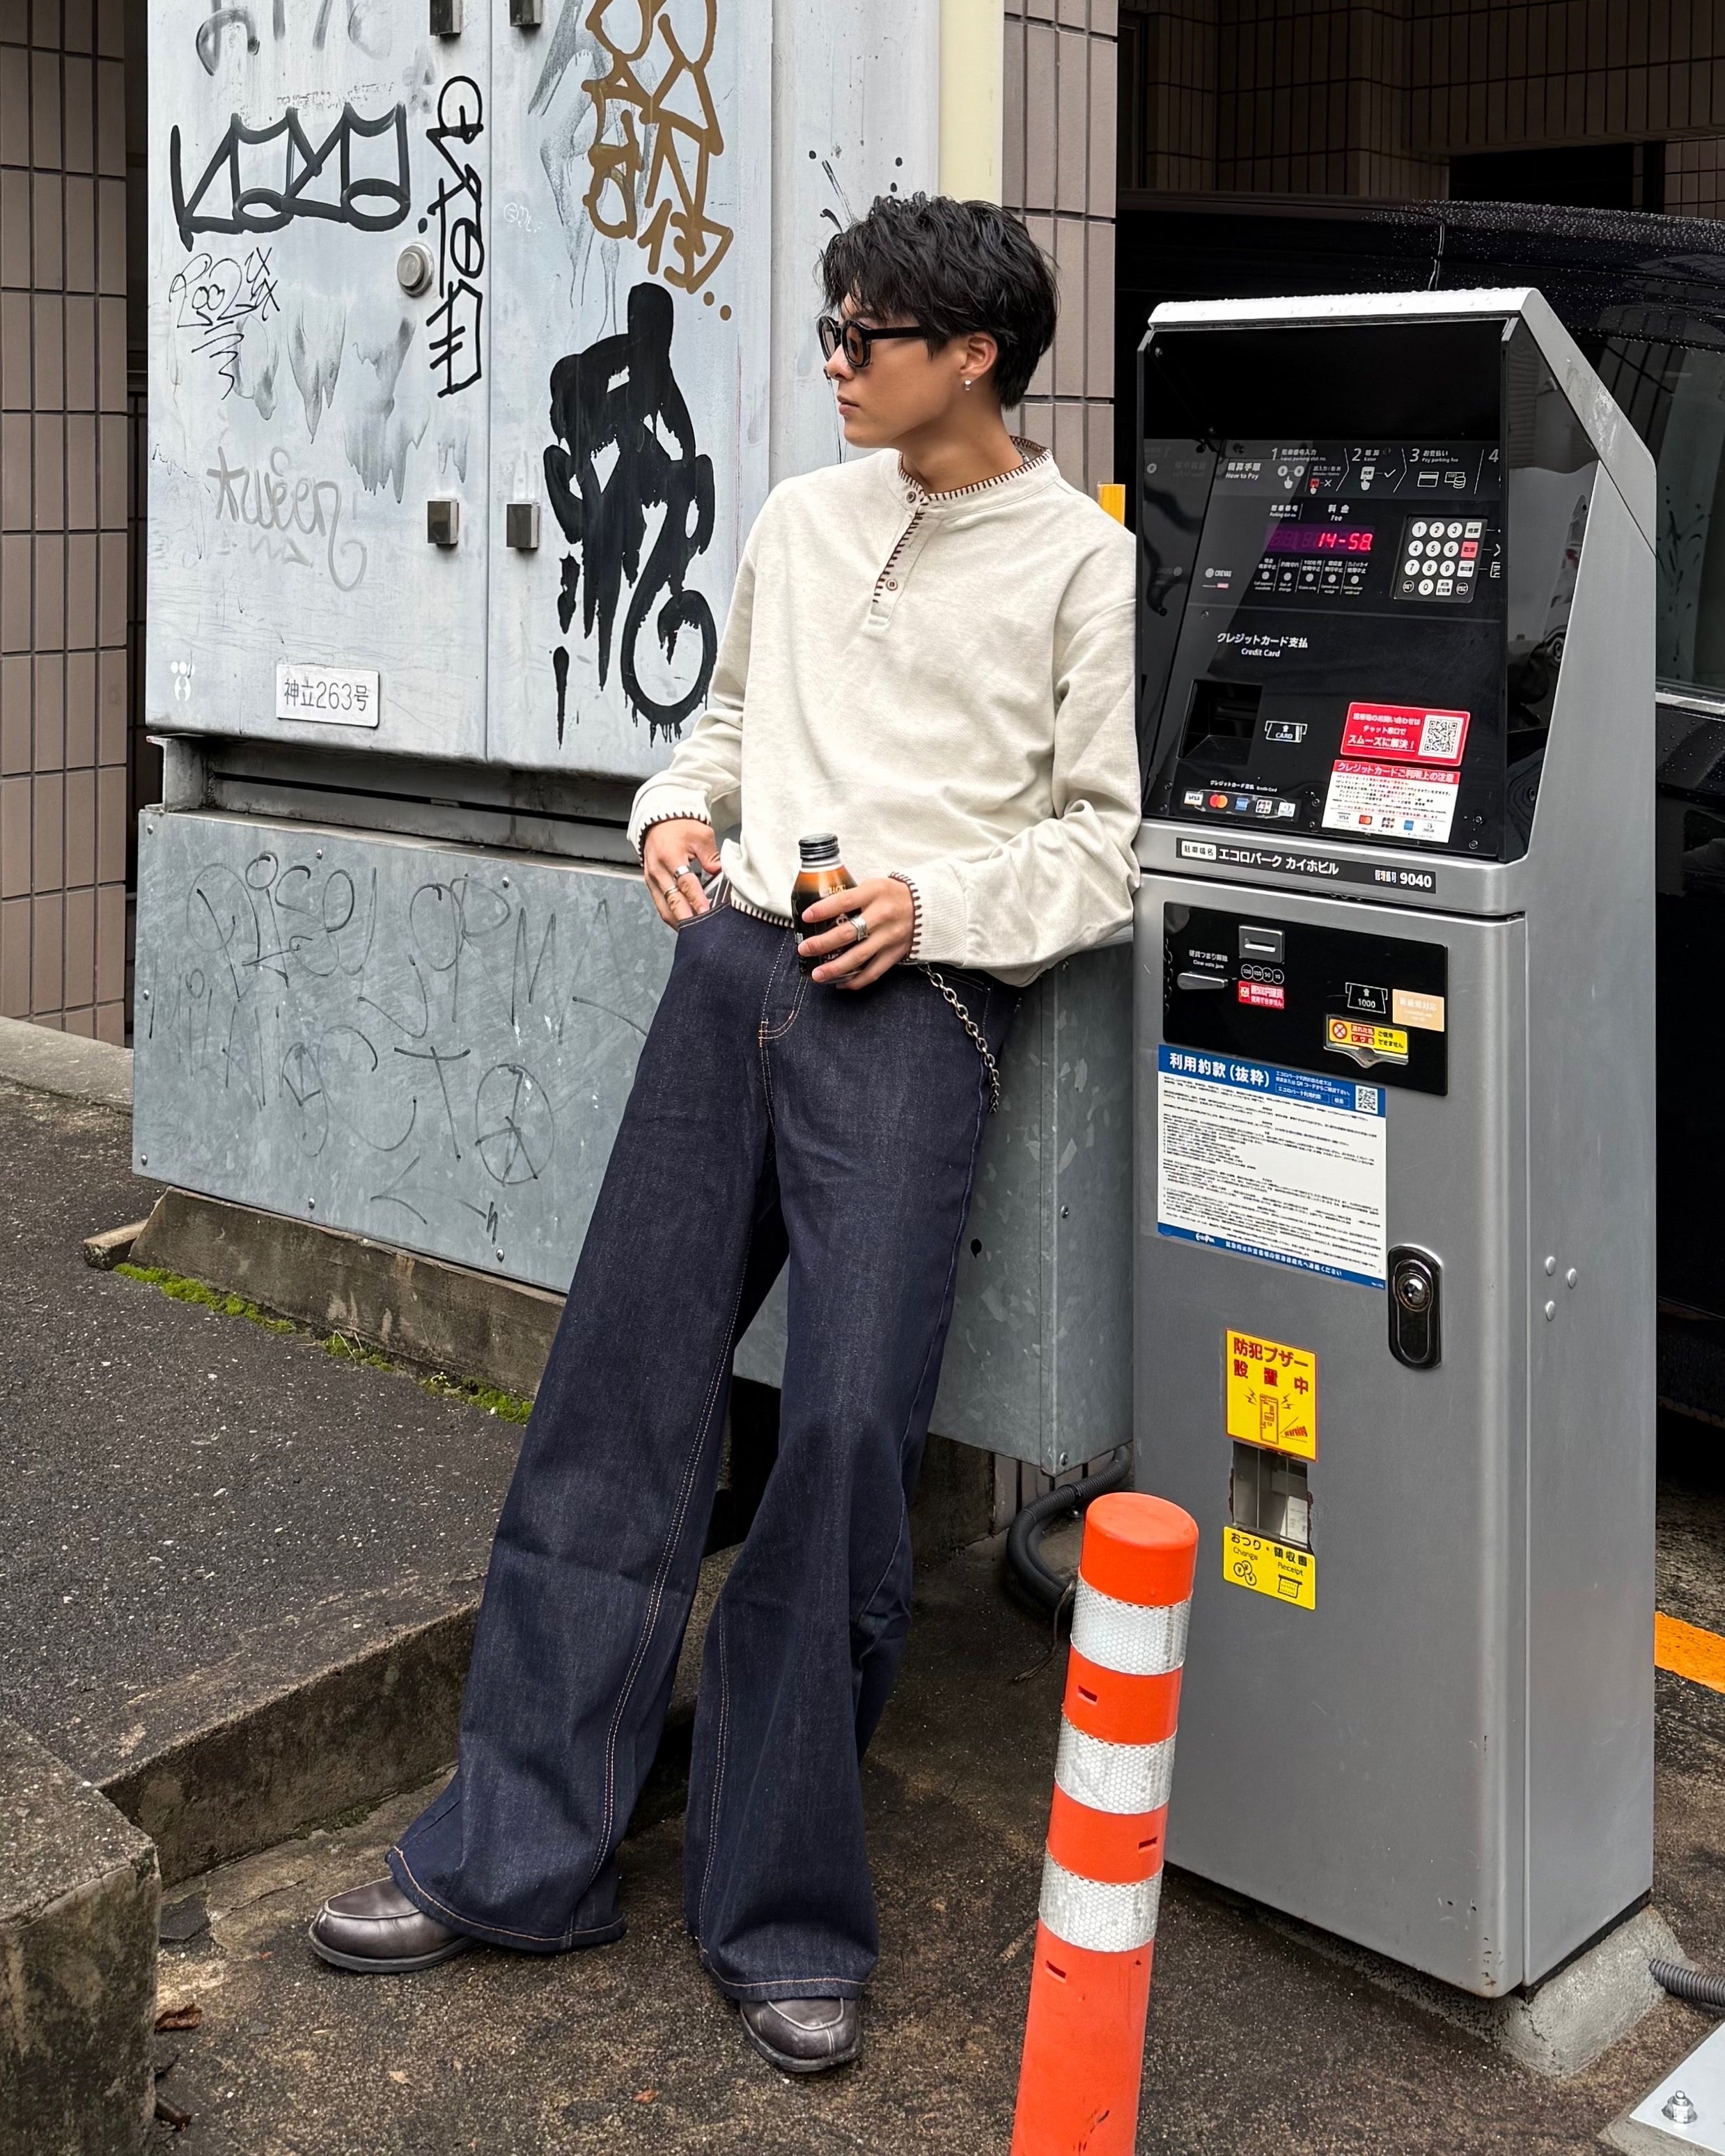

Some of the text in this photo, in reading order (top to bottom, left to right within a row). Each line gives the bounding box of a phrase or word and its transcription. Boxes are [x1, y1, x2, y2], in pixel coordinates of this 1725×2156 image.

[1352, 448, 1361, 462] 2
[1410, 448, 1420, 462] 3
[1217, 632, 1308, 648] クレジットカード支払
[1241, 648, 1280, 657] Credit Card
[284, 678, 368, 711] 神立263号
[1219, 848, 1281, 867] エコロパーク
[1286, 857, 1339, 875] カイホビル
[1400, 873, 1432, 888] 9040
[1358, 998, 1375, 1008] 1000
[1233, 1336, 1309, 1367] 防犯ブザー
[1233, 1547, 1258, 1561] Change
[1278, 1562, 1304, 1576] Receipt
